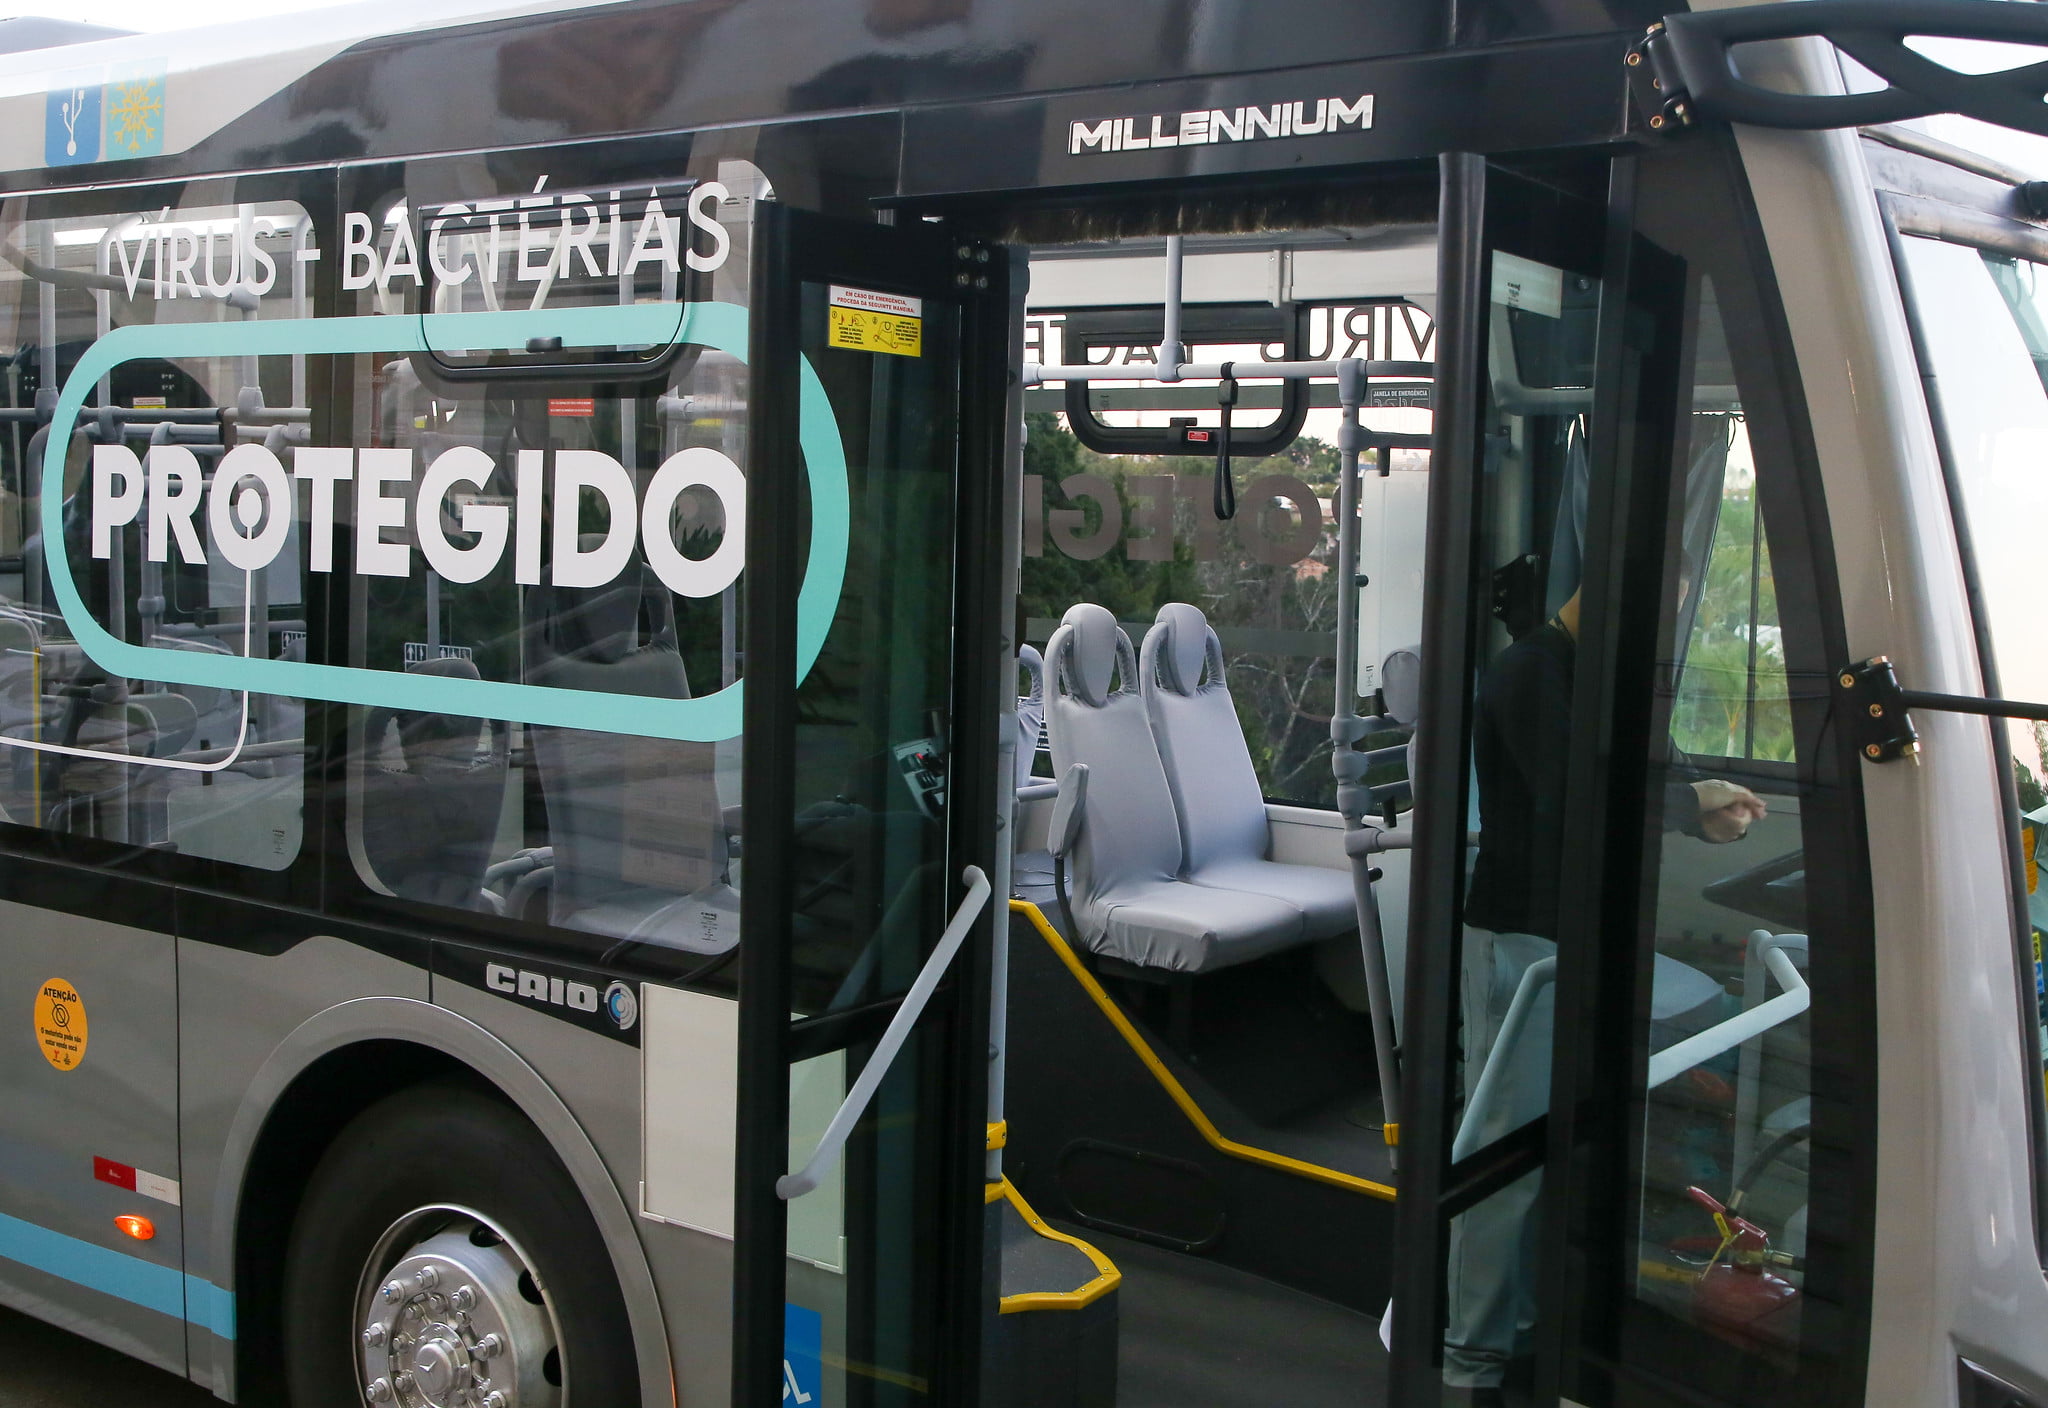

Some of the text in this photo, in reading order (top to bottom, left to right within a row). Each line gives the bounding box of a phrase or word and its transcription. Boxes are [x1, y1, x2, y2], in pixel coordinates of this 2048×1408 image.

[1068, 94, 1374, 154] MILLENNIUM
[115, 205, 276, 303] VÍRUS
[342, 174, 731, 290] BACTÉRIAS
[837, 297, 860, 305] PROCEDA
[854, 292, 867, 300] CASO
[91, 443, 747, 598] PROTEGIDO
[44, 987, 76, 1002] ATENÇÃO
[486, 961, 598, 1013] CAIO
